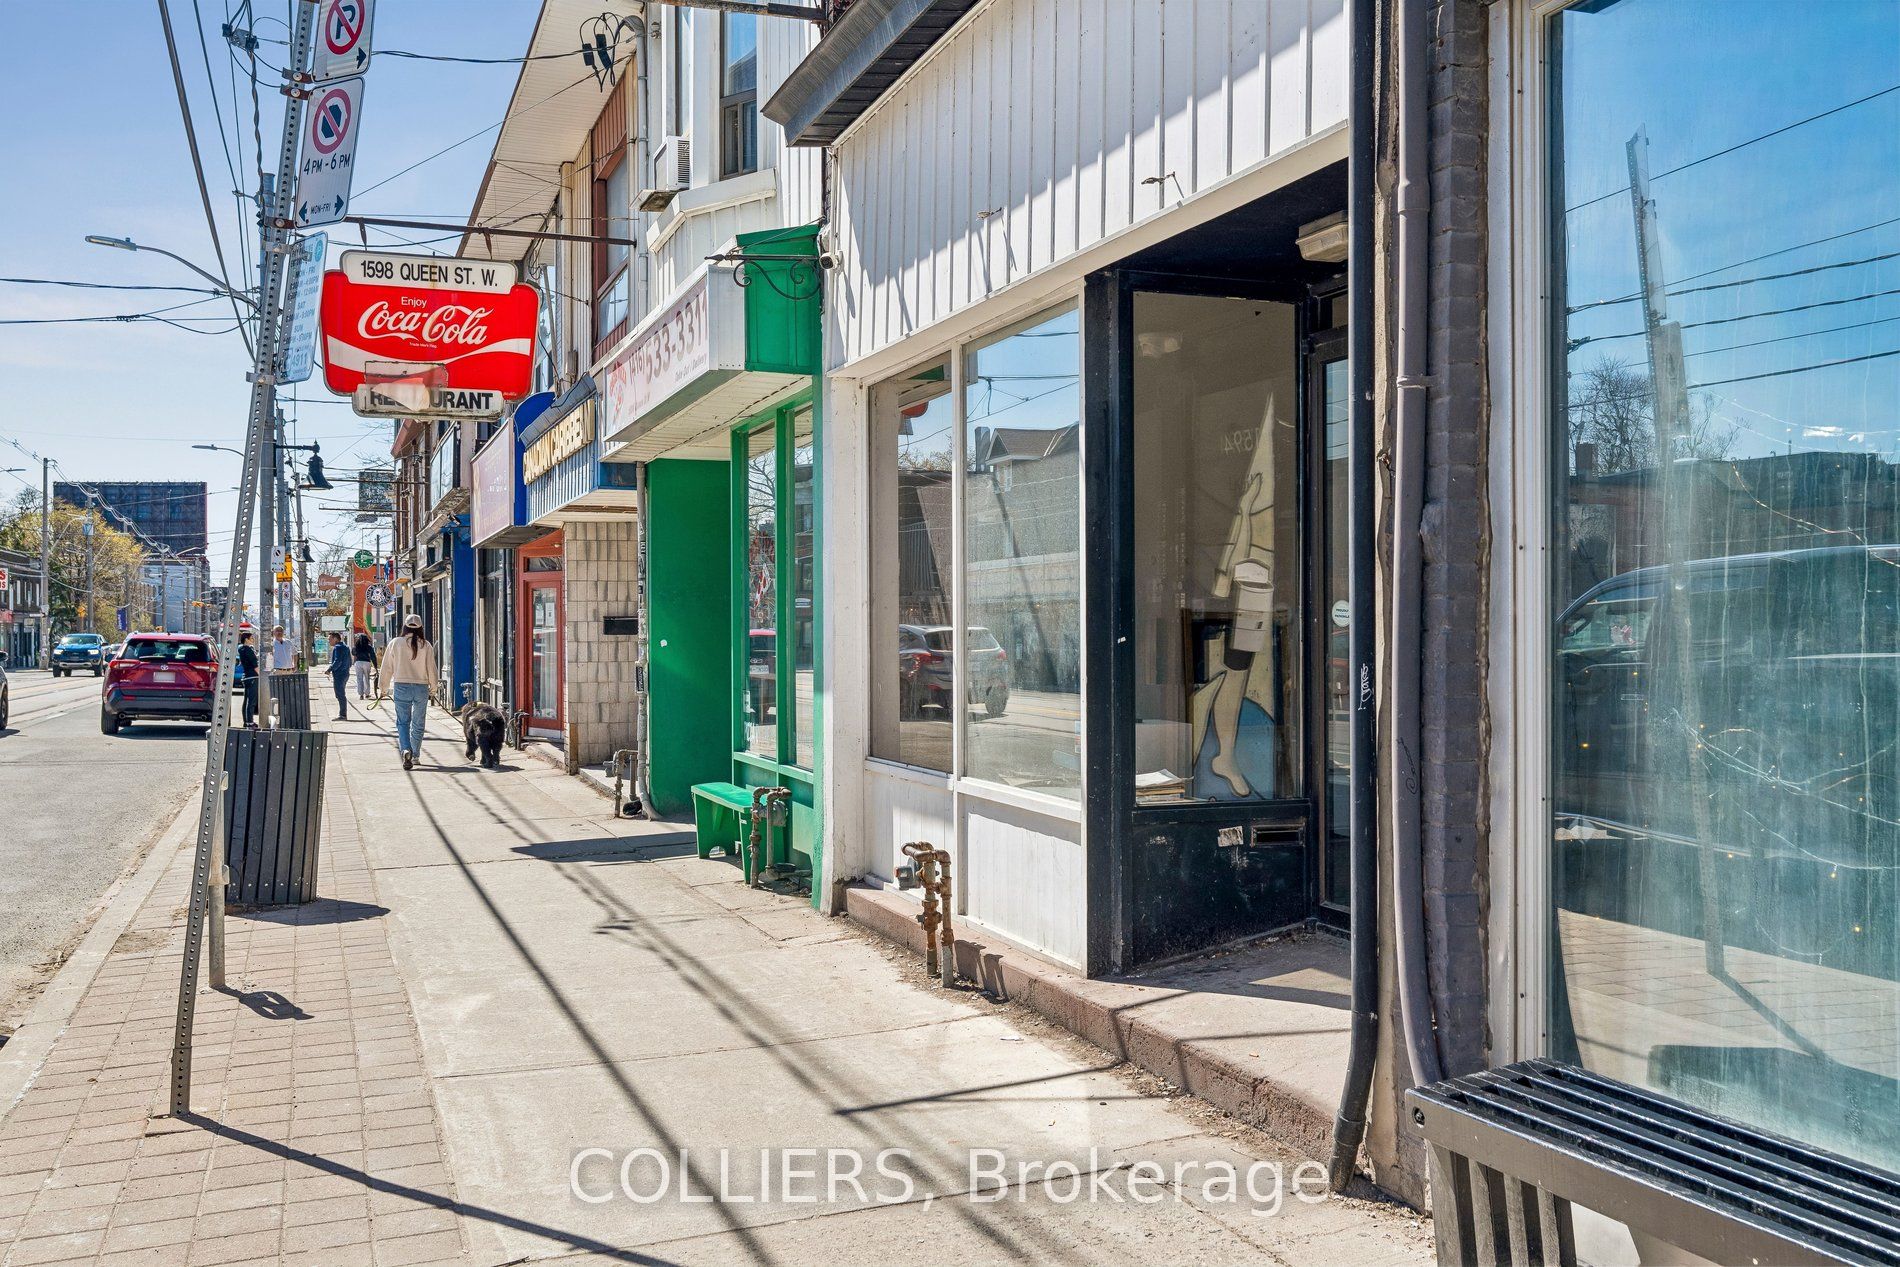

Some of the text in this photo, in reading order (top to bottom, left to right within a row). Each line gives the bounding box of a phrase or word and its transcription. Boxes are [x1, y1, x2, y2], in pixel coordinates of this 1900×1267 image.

[361, 260, 498, 287] 1598 QUEEN ST. W.
[401, 296, 427, 308] Enjoy
[357, 301, 494, 345] Coca-Cola
[370, 387, 493, 410] REURANT
